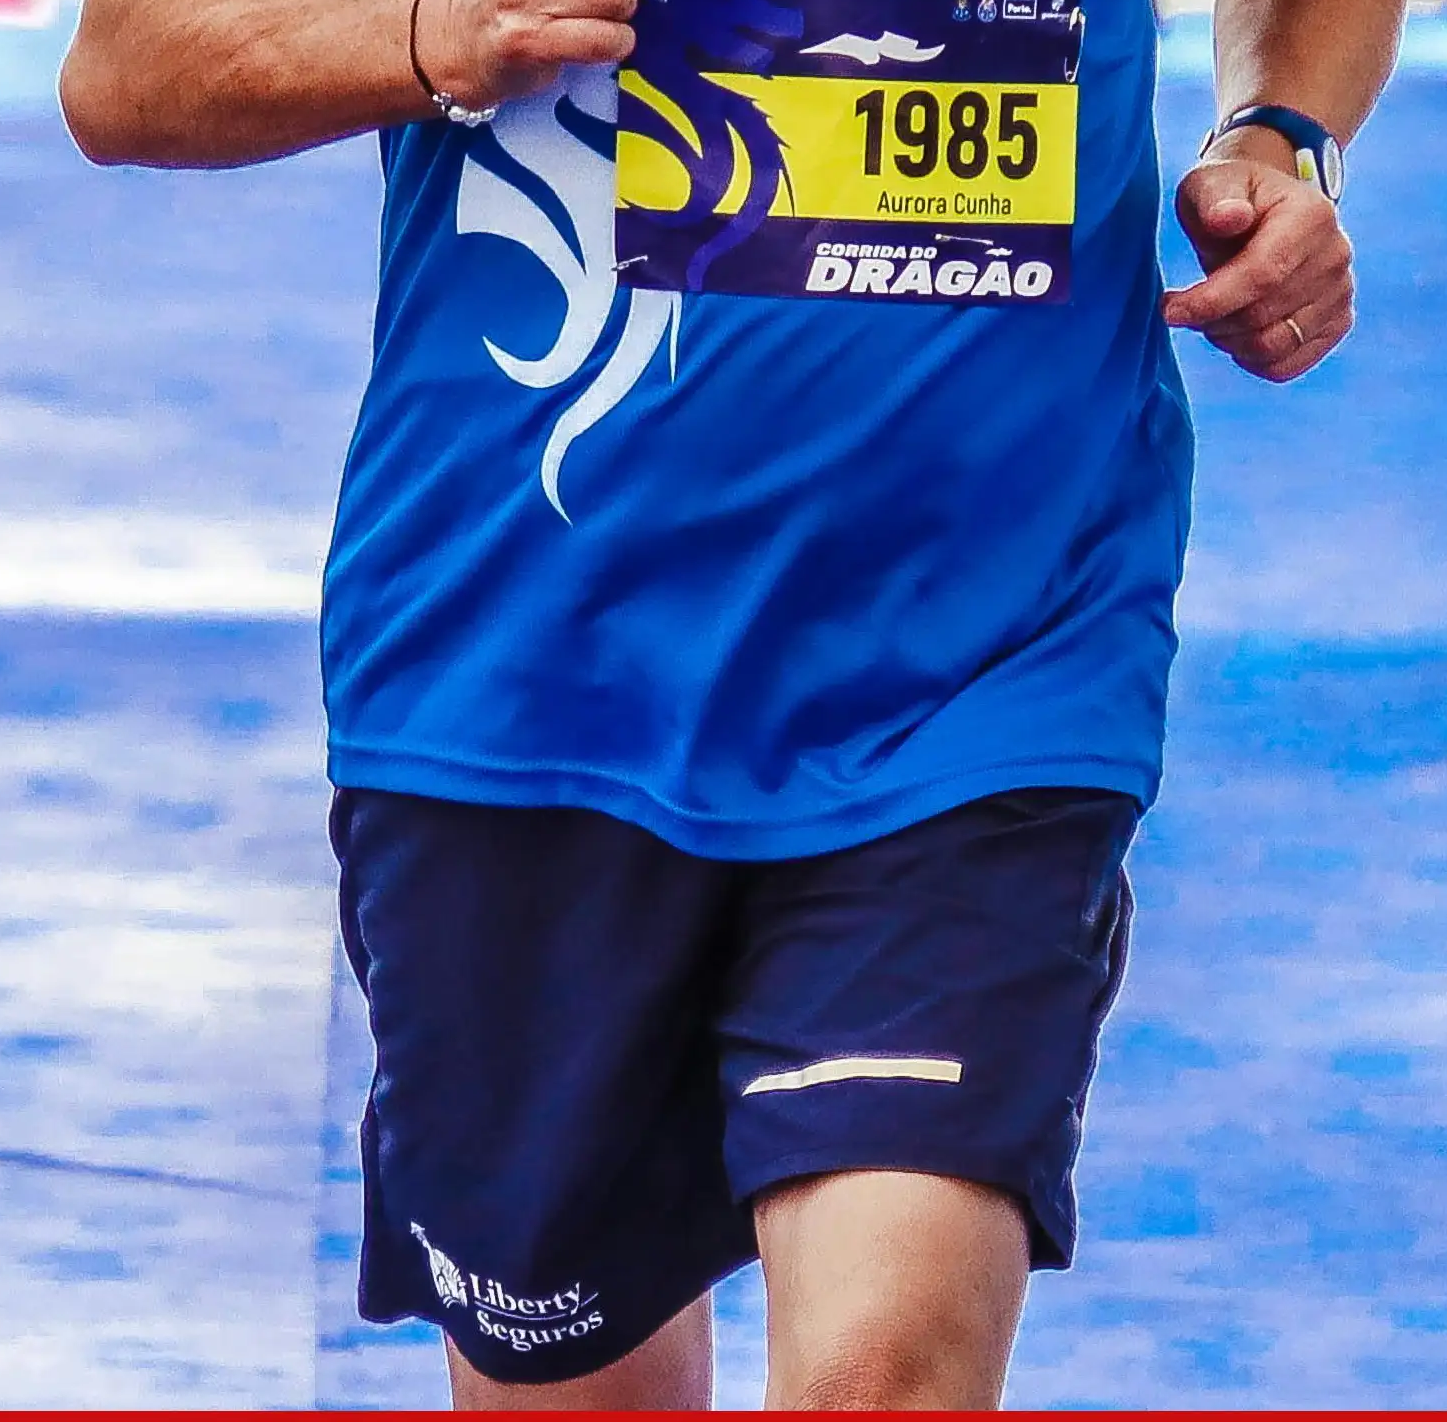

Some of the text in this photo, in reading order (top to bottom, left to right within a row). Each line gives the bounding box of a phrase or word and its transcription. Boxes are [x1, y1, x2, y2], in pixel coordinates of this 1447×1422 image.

[854, 89, 1039, 180] 1985
[876, 190, 1012, 215] Aurora Cunha
[805, 247, 1054, 297] DRAGÃO
[816, 242, 938, 260] CORRIDA DO
[469, 1273, 581, 1316] Liberty
[476, 1309, 604, 1353] Seguros
